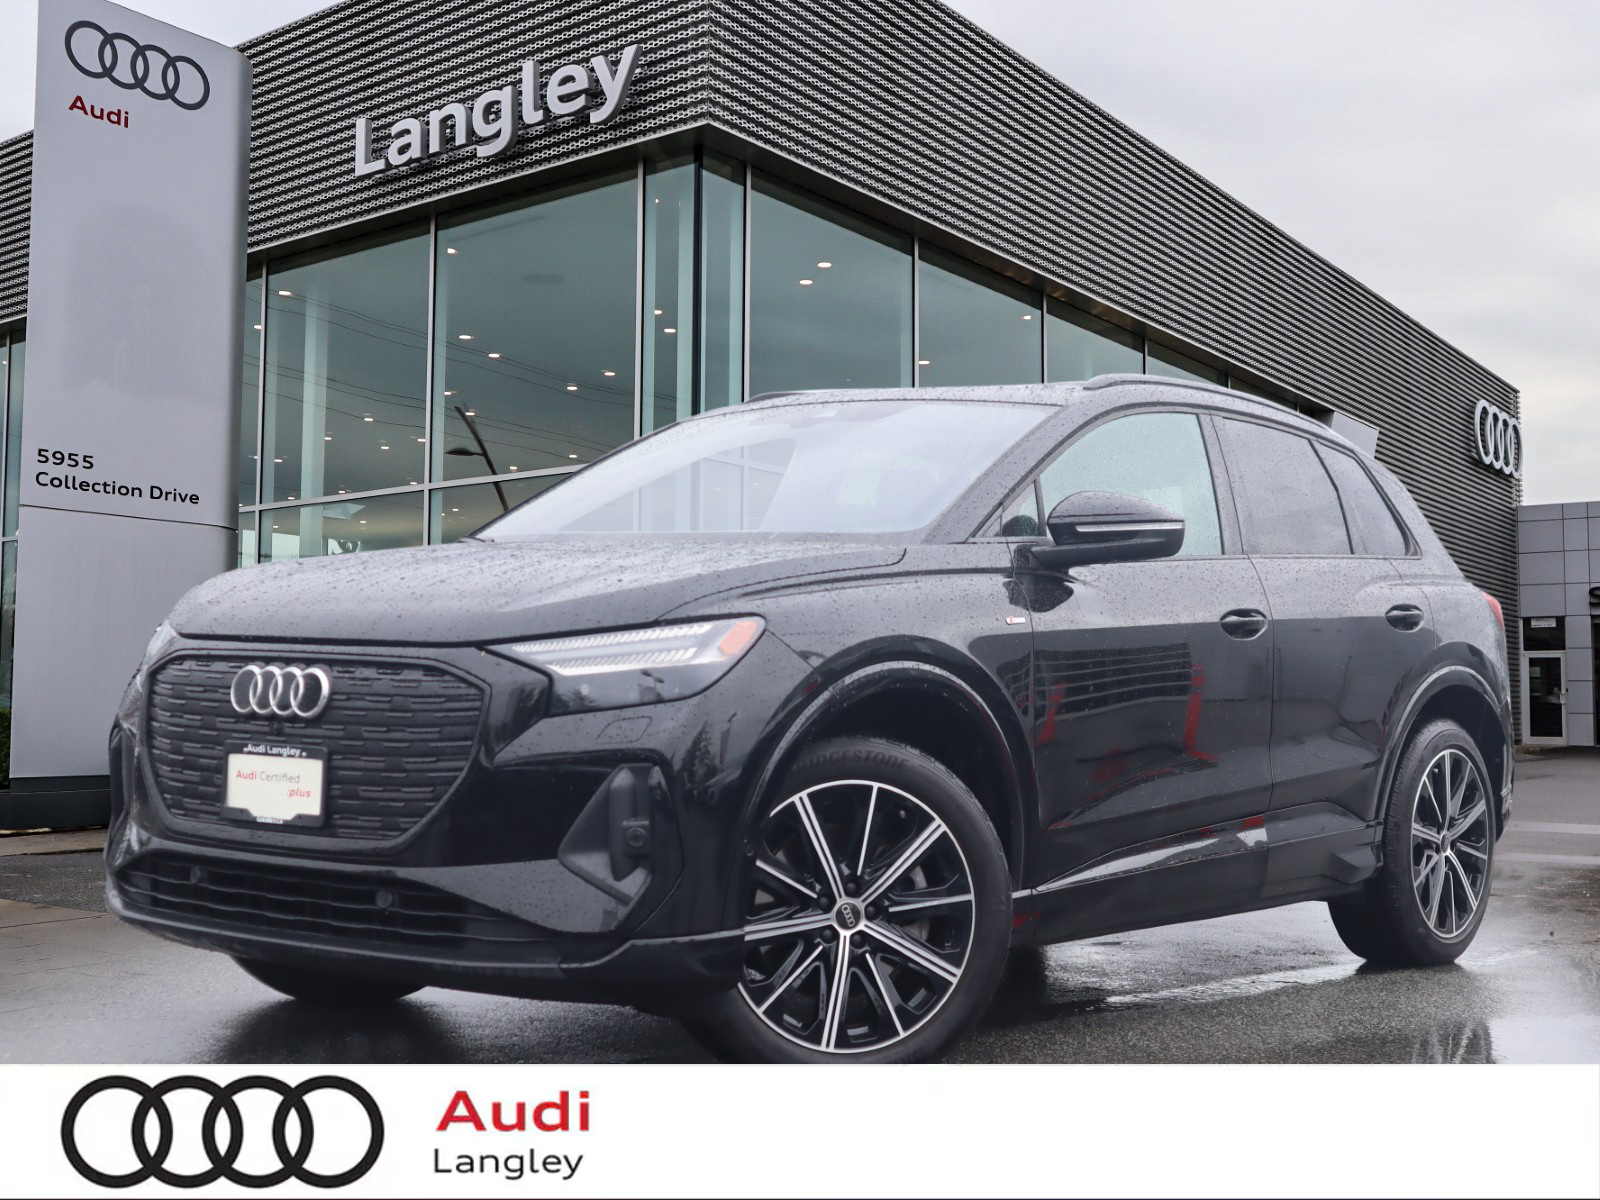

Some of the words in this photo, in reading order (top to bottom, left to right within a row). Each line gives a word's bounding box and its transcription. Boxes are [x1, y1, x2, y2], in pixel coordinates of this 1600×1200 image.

[68, 95, 130, 129] Audi
[354, 44, 643, 178] Langley
[36, 448, 95, 470] 5955
[35, 471, 143, 498] Collection
[149, 485, 200, 505] Drive
[246, 744, 266, 753] Audi
[266, 745, 301, 757] Langley
[235, 770, 257, 780] Audi
[259, 771, 301, 784] Certified
